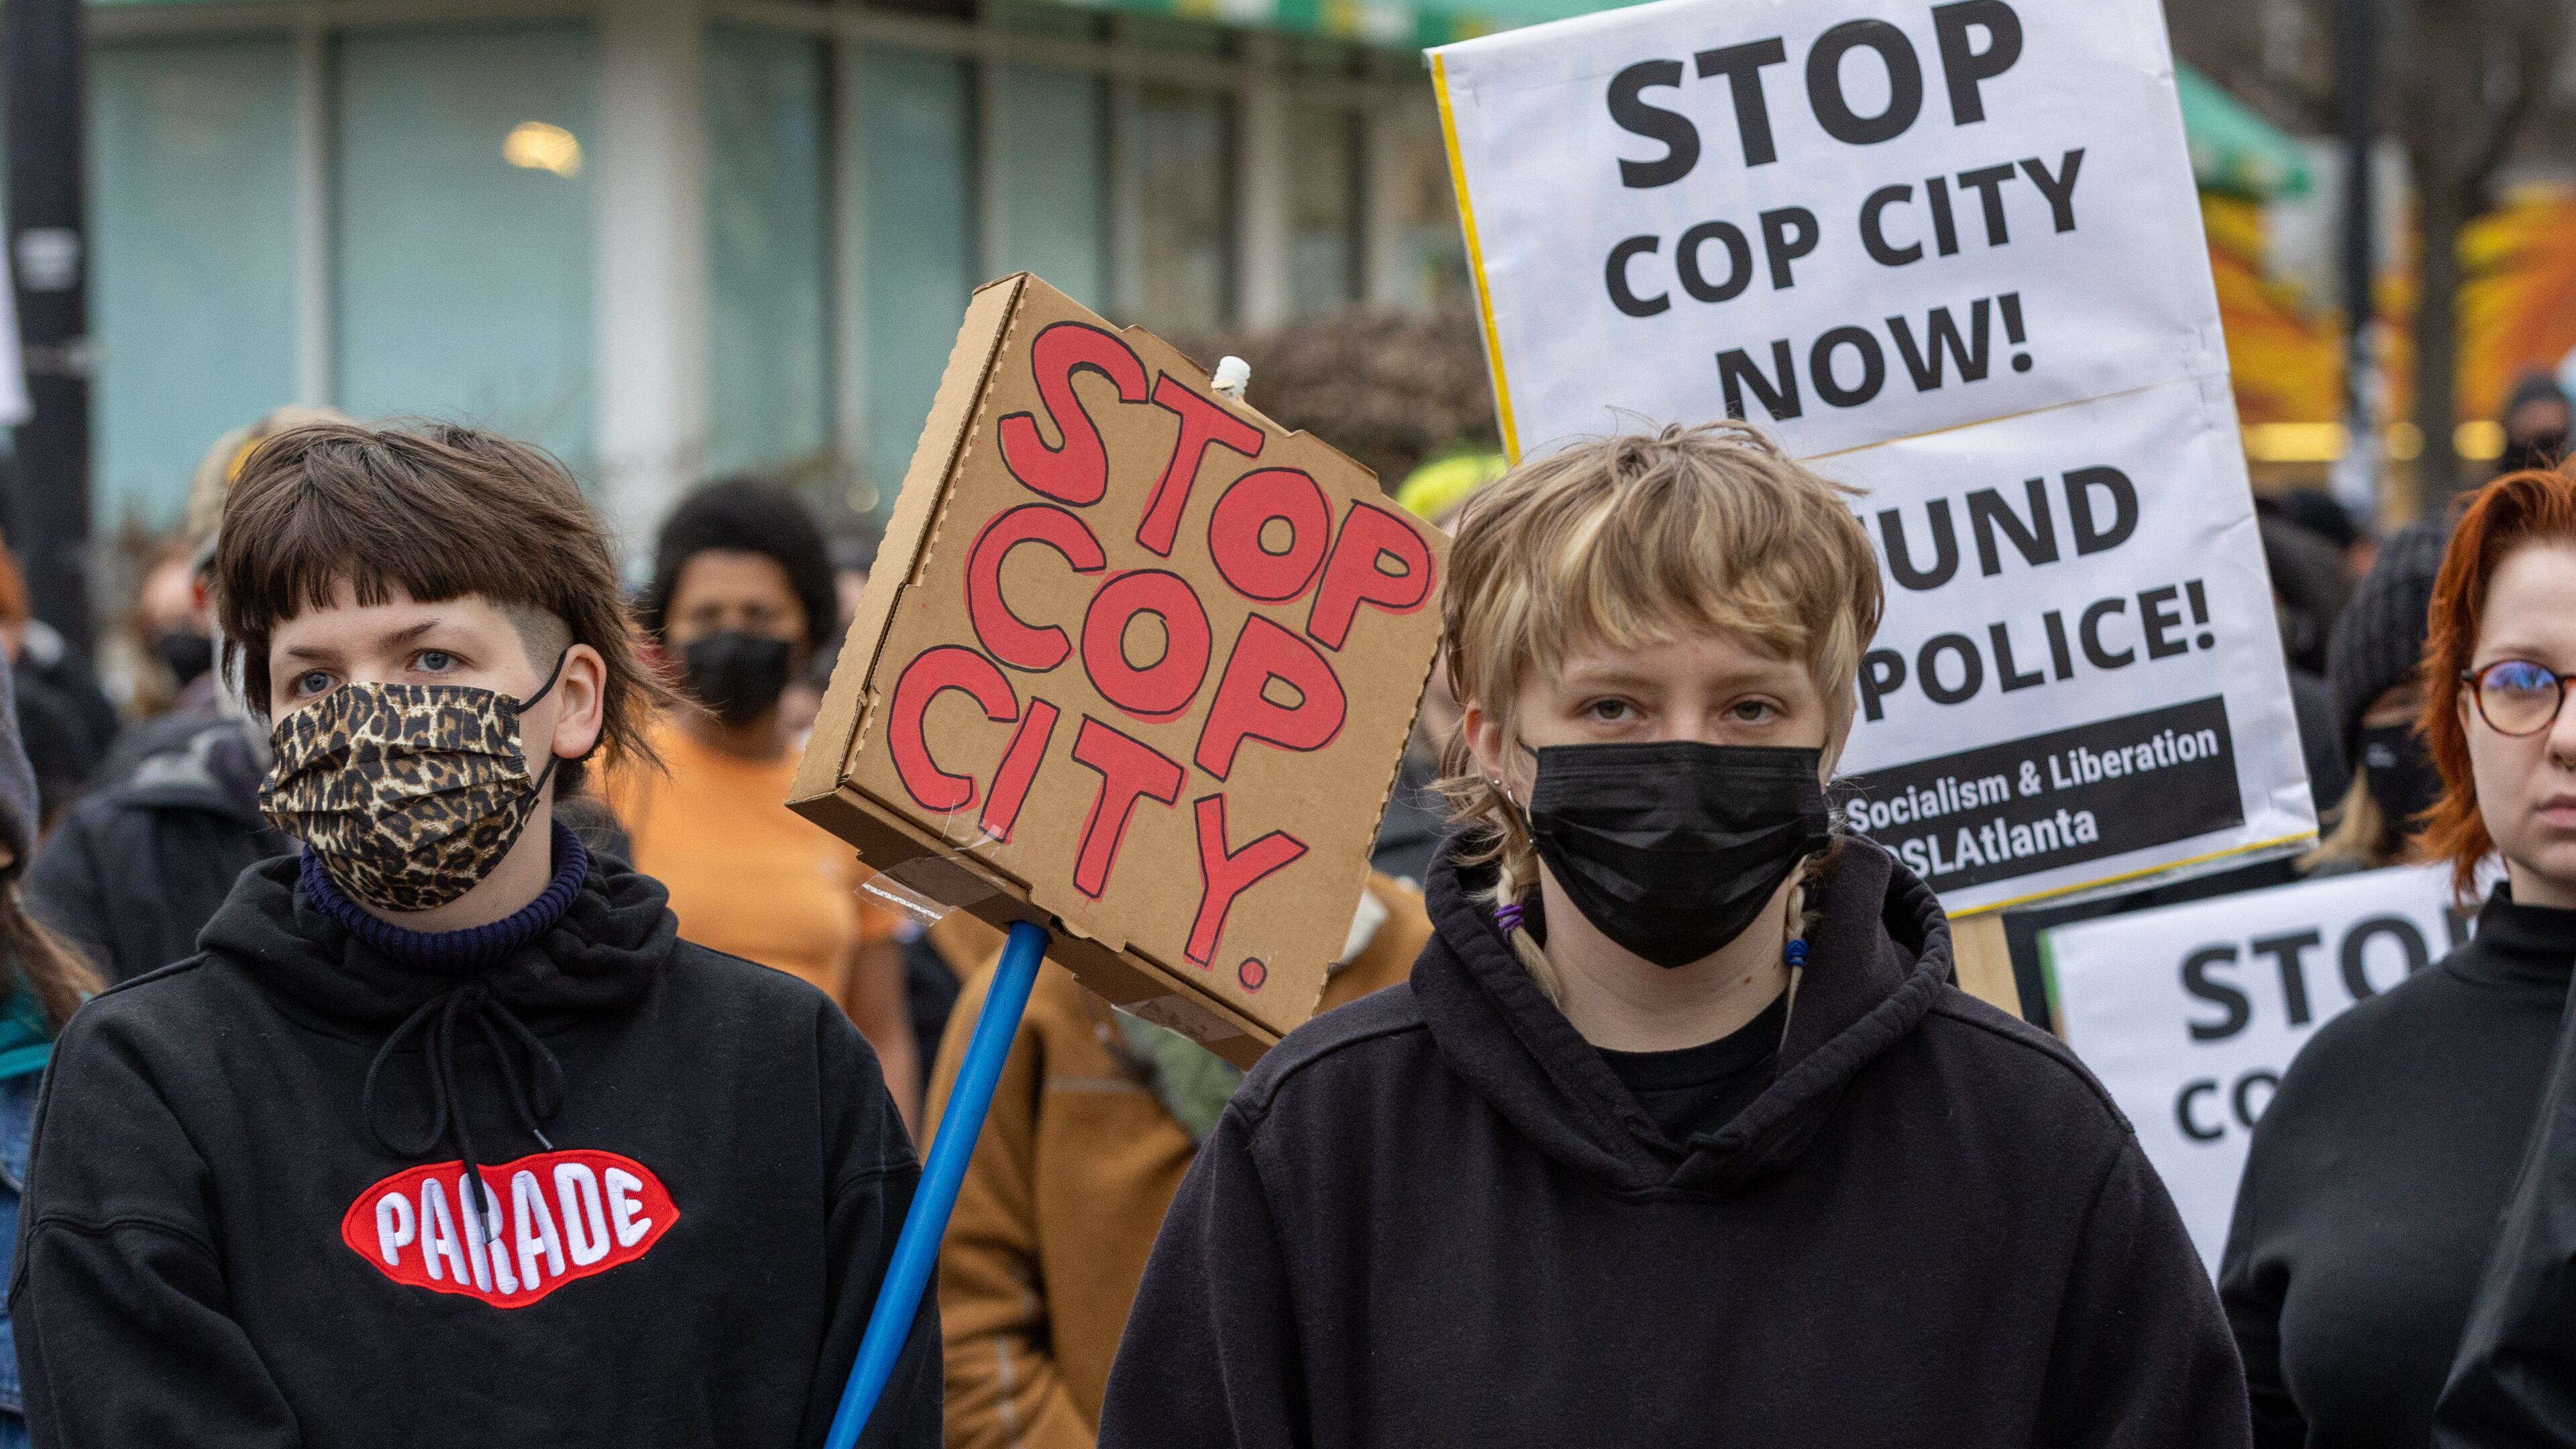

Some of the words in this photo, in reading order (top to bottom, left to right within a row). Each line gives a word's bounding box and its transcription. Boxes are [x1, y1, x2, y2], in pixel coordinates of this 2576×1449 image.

[1606, 0, 2023, 189] STOP
[1605, 206, 1821, 318] COP
[1859, 147, 2086, 267] CITY
[1716, 292, 2033, 421] NOW!
[997, 320, 1436, 651] STOP
[1857, 465, 2139, 592] UND
[963, 502, 1347, 782] COP
[1857, 578, 2216, 722] POLICE!
[886, 643, 1309, 992] CITY.
[1845, 773, 2010, 834] Socialism
[2018, 760, 2043, 797] &
[2049, 728, 2219, 790] Liberation
[1881, 808, 2100, 879] SLAtlanta
[2178, 906, 2478, 1044] STO
[376, 1163, 652, 1295] PARADE
